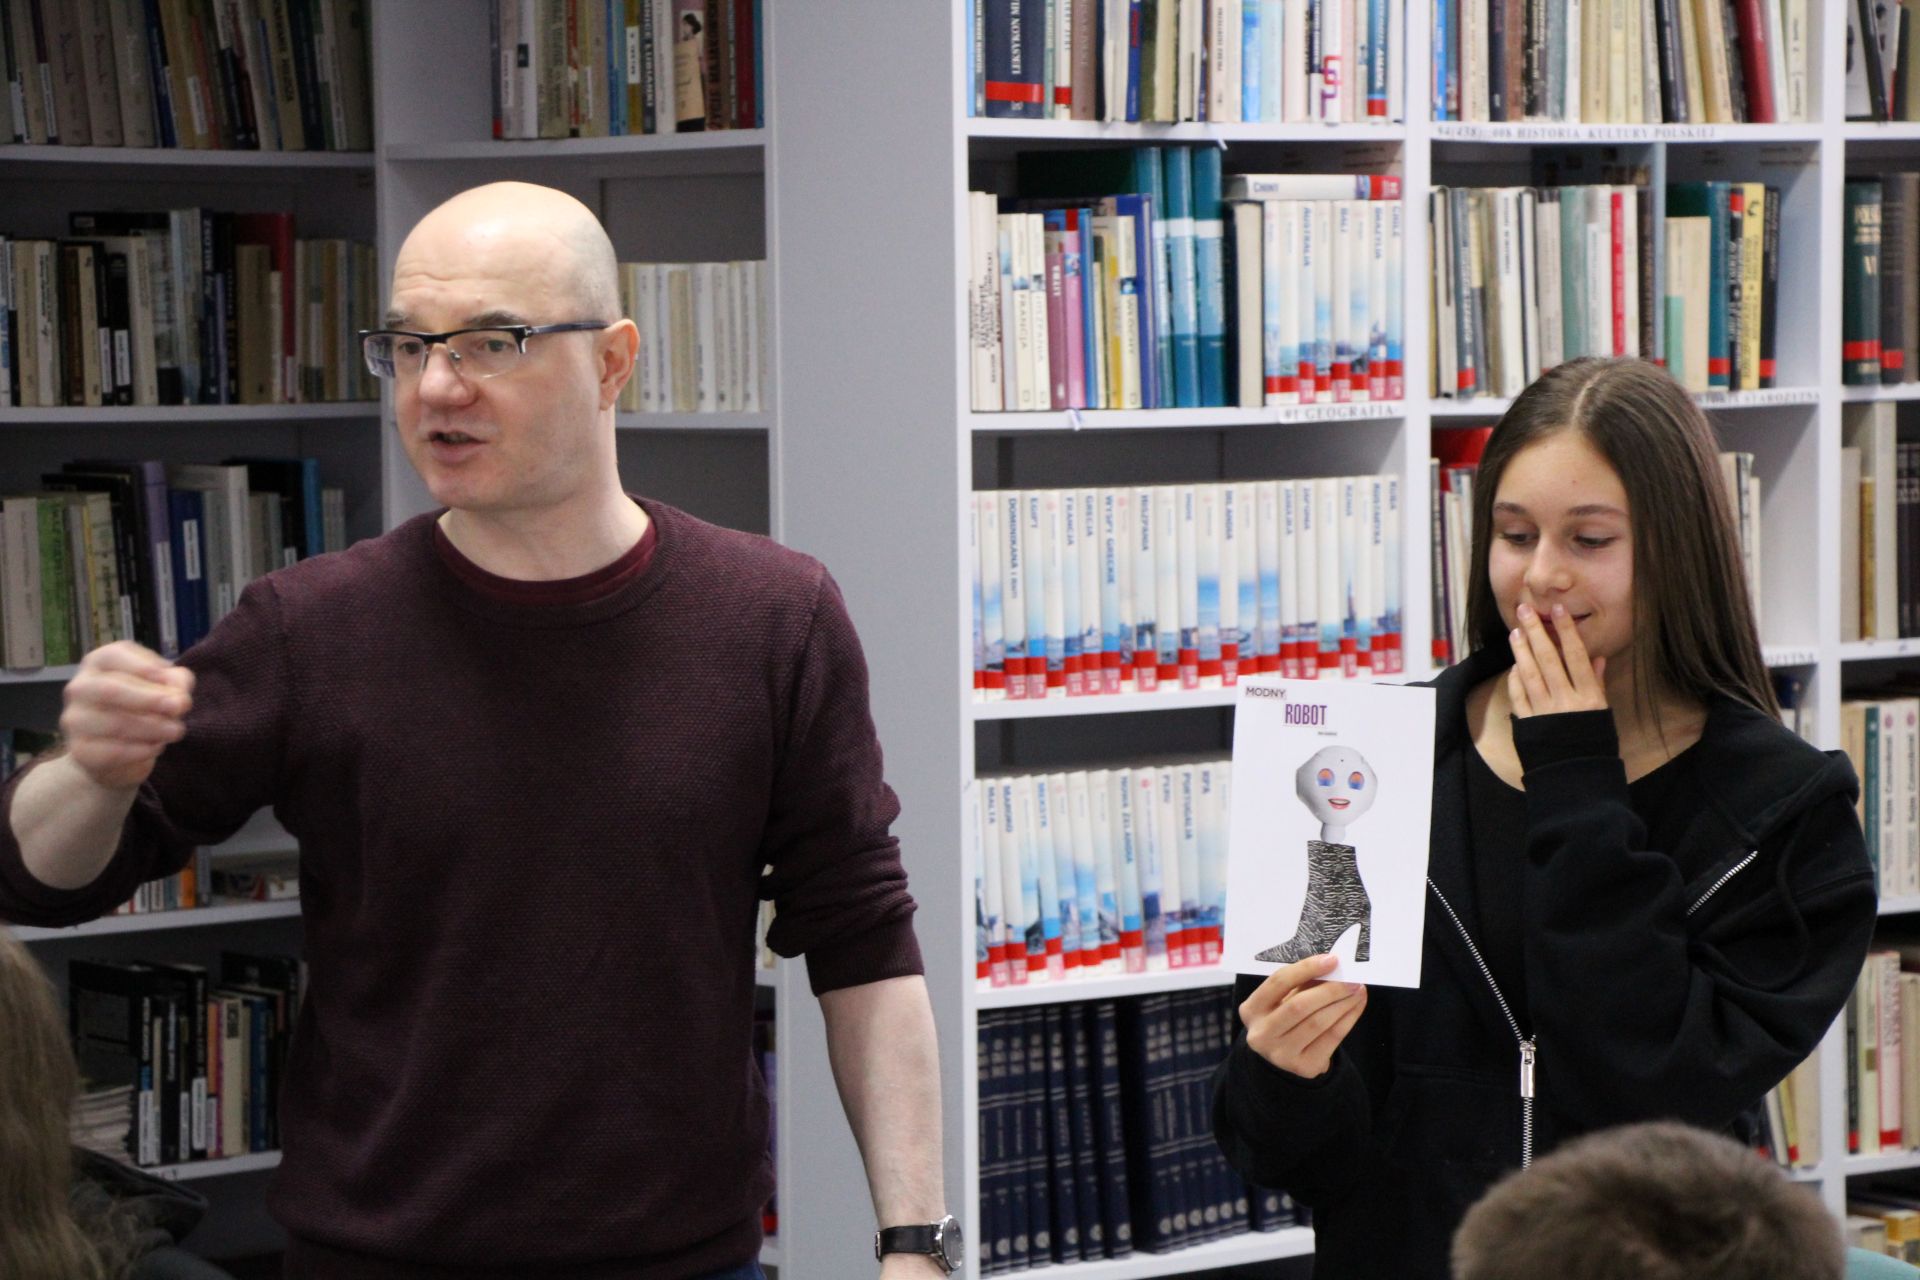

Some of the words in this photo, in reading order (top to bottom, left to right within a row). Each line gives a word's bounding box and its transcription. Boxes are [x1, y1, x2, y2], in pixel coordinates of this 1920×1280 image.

[1011, 18, 1021, 74] LEKSYKON
[1518, 127, 1580, 138] HISTORIA
[1588, 127, 1648, 138] KULTURY
[1303, 207, 1311, 267] AUSTRALIA
[1019, 293, 1028, 350] FRANCJA
[1304, 405, 1393, 420] GEOGRAFIA
[1008, 498, 1019, 569] DOMINIKANA
[1030, 497, 1038, 528] EGIPT
[1066, 497, 1074, 546] FRANCJA
[1141, 495, 1149, 551] HISZPANIA
[1106, 538, 1115, 584] GRECKIE
[1246, 687, 1286, 698] MODNY
[1285, 704, 1327, 725] ROBOT
[1182, 772, 1192, 840] PORTUGALIA
